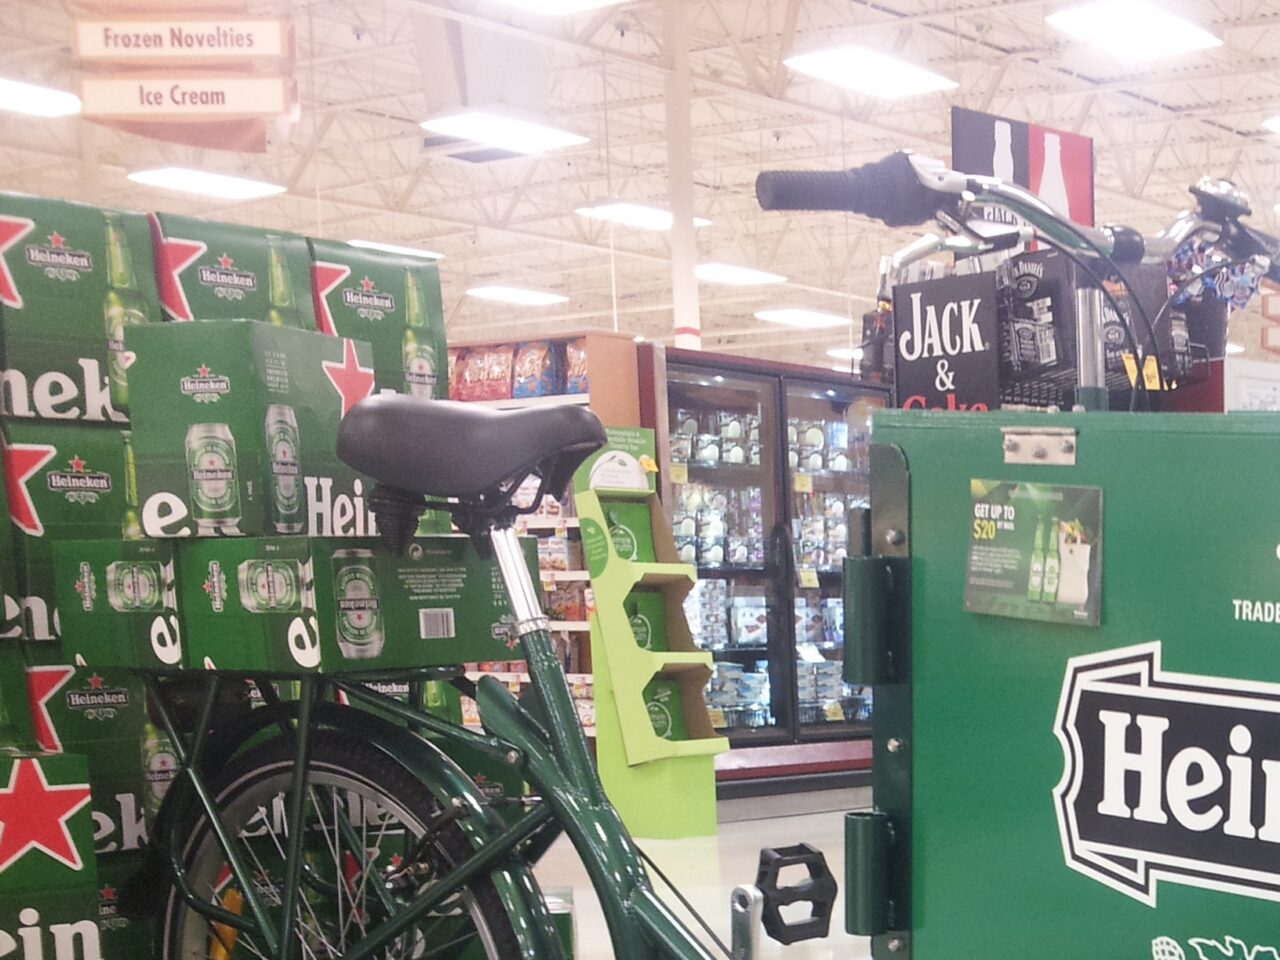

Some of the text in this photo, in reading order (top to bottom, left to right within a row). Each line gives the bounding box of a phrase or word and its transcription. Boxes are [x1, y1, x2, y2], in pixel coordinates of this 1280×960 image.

[104, 26, 255, 48] Frozen Novelties
[139, 85, 226, 106] Ice Cream
[28, 247, 89, 268] Heineken
[200, 269, 254, 287] Heineken
[345, 292, 392, 308] Heineken
[899, 292, 985, 361] JACK
[935, 359, 955, 391] &
[183, 379, 228, 391] Heineken
[50, 474, 109, 489] Heineken
[974, 503, 1015, 521] GET UP TO
[973, 519, 996, 540] $20
[69, 691, 127, 705] Heineken
